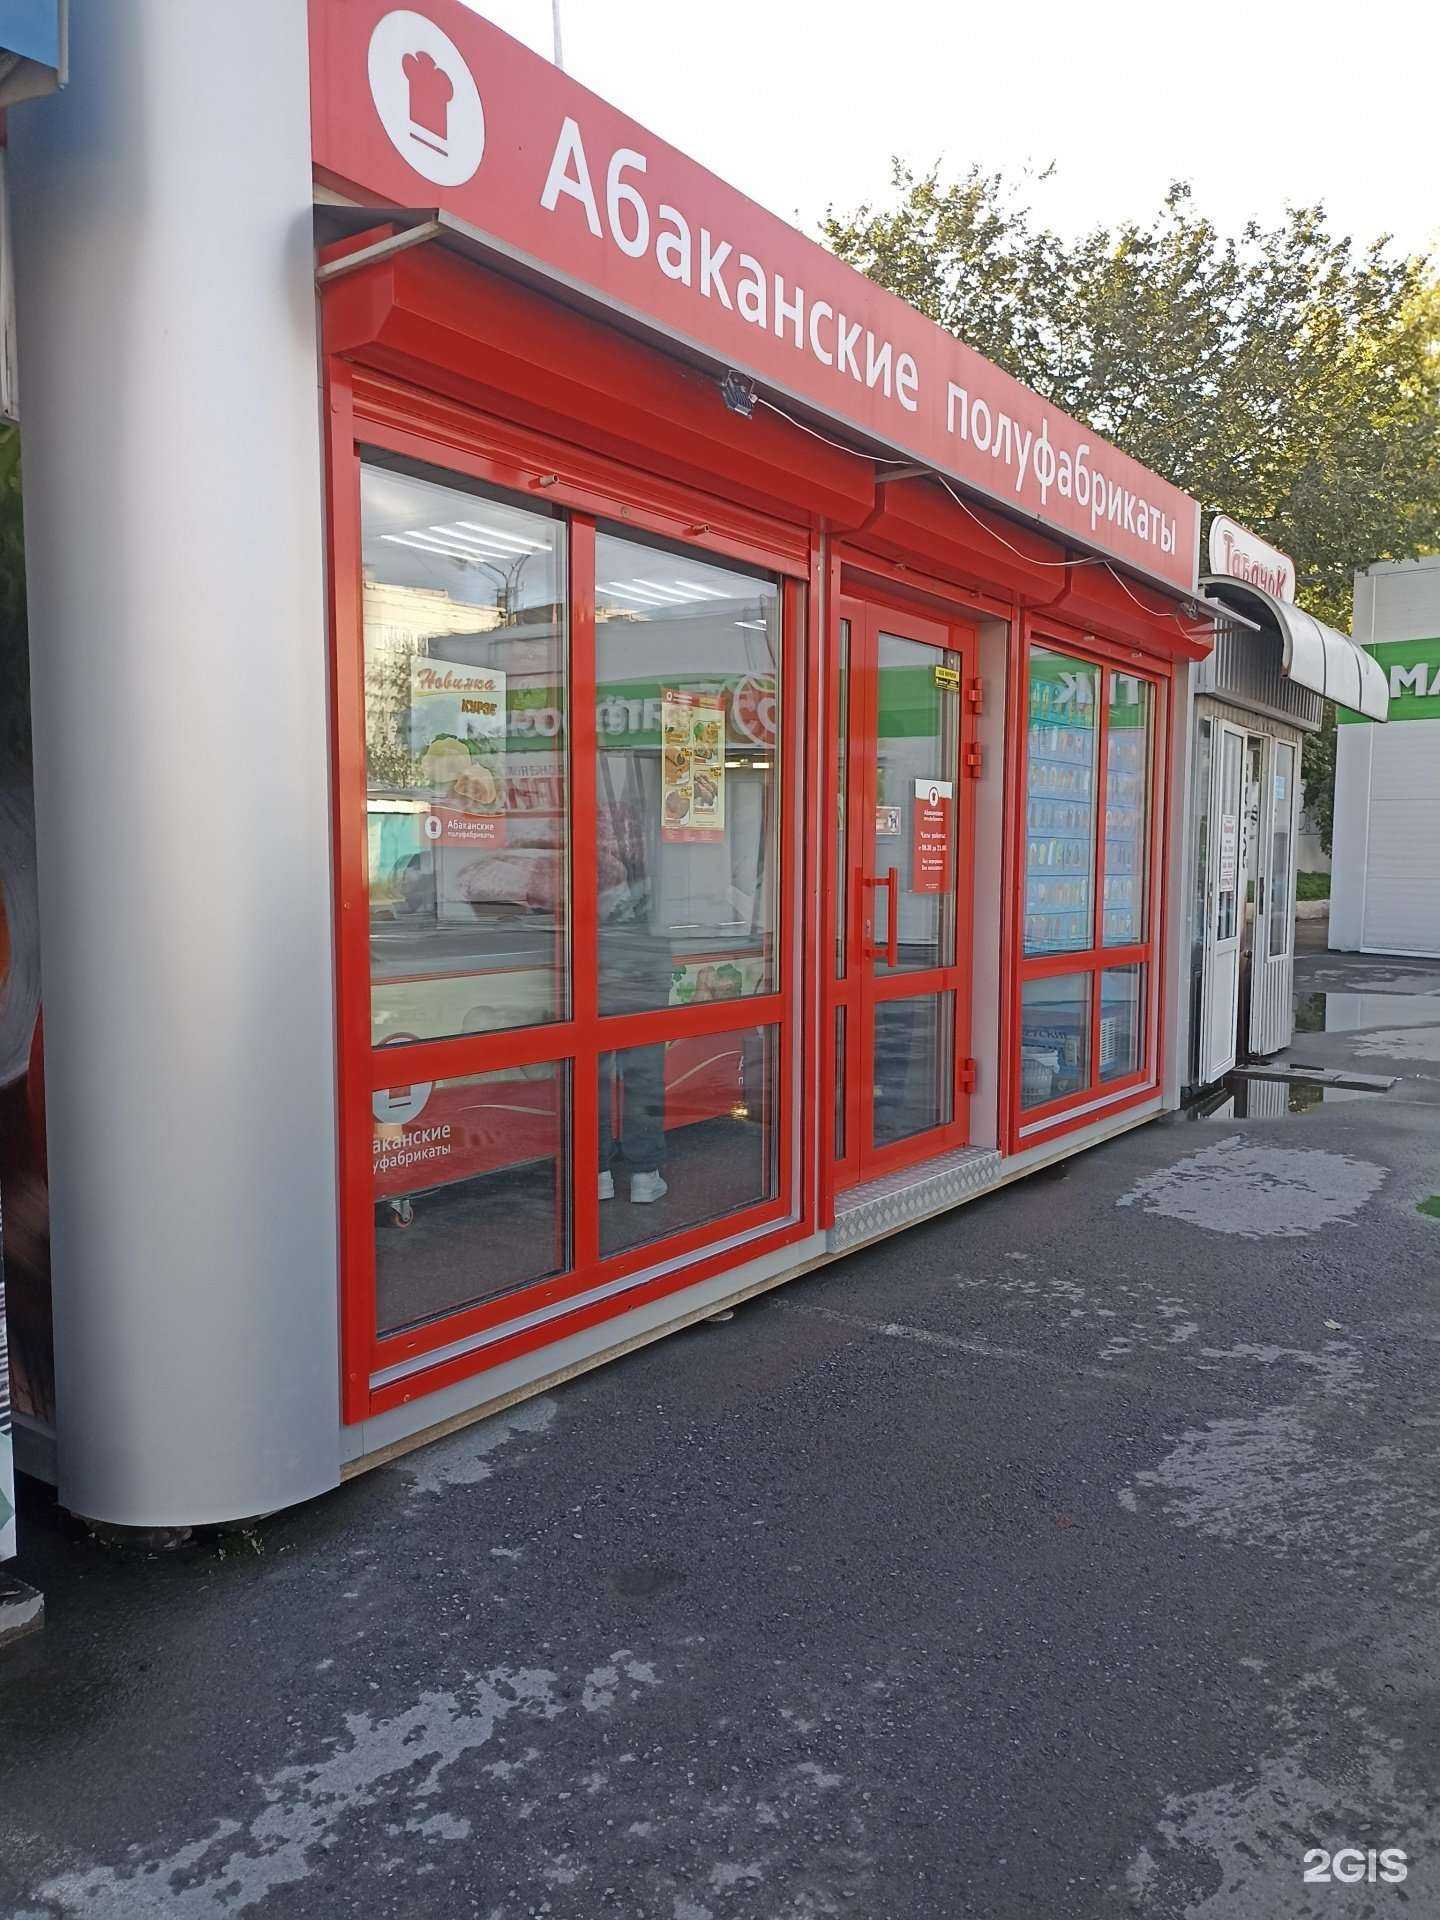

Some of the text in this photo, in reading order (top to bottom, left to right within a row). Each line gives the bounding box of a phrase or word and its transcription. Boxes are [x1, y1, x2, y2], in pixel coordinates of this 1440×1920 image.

[541, 116, 1176, 555] Абаканские полуфабрикаты
[418, 668, 496, 691] Новинка
[447, 819, 495, 831] Абаканские
[372, 1125, 451, 1154] аканские
